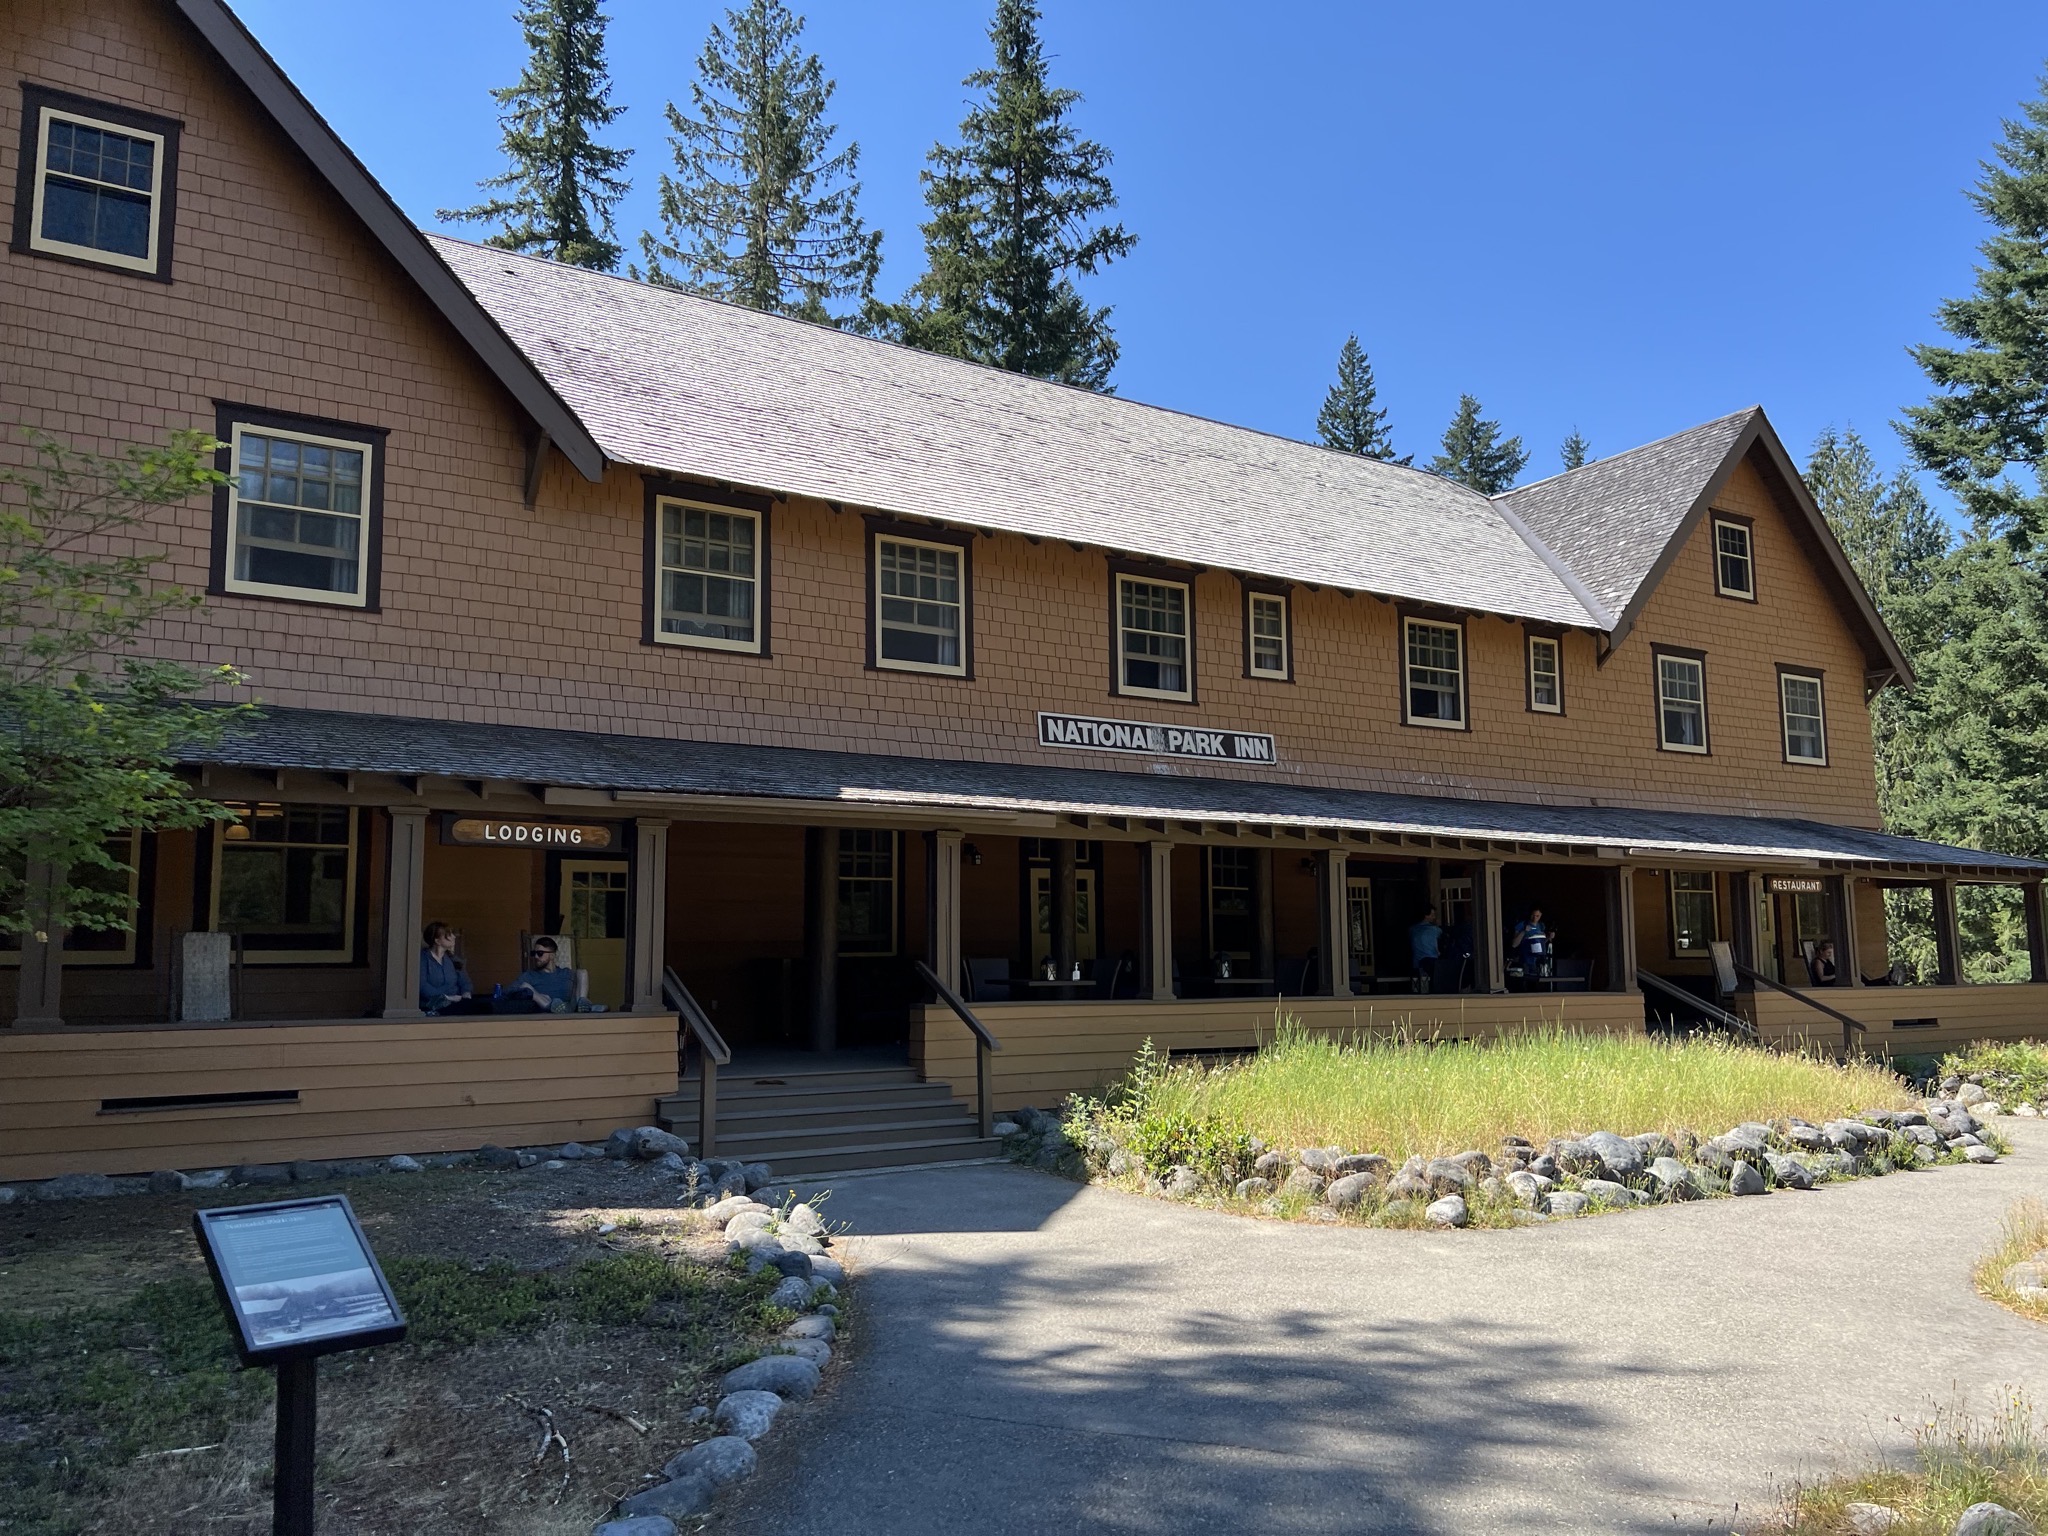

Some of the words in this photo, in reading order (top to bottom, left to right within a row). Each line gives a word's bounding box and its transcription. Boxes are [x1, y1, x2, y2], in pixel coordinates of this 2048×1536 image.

[1168, 730, 1226, 755] PARK
[1234, 736, 1269, 760] INN
[485, 824, 582, 844] LODGING
[1772, 880, 1820, 891] RESTAURANT
